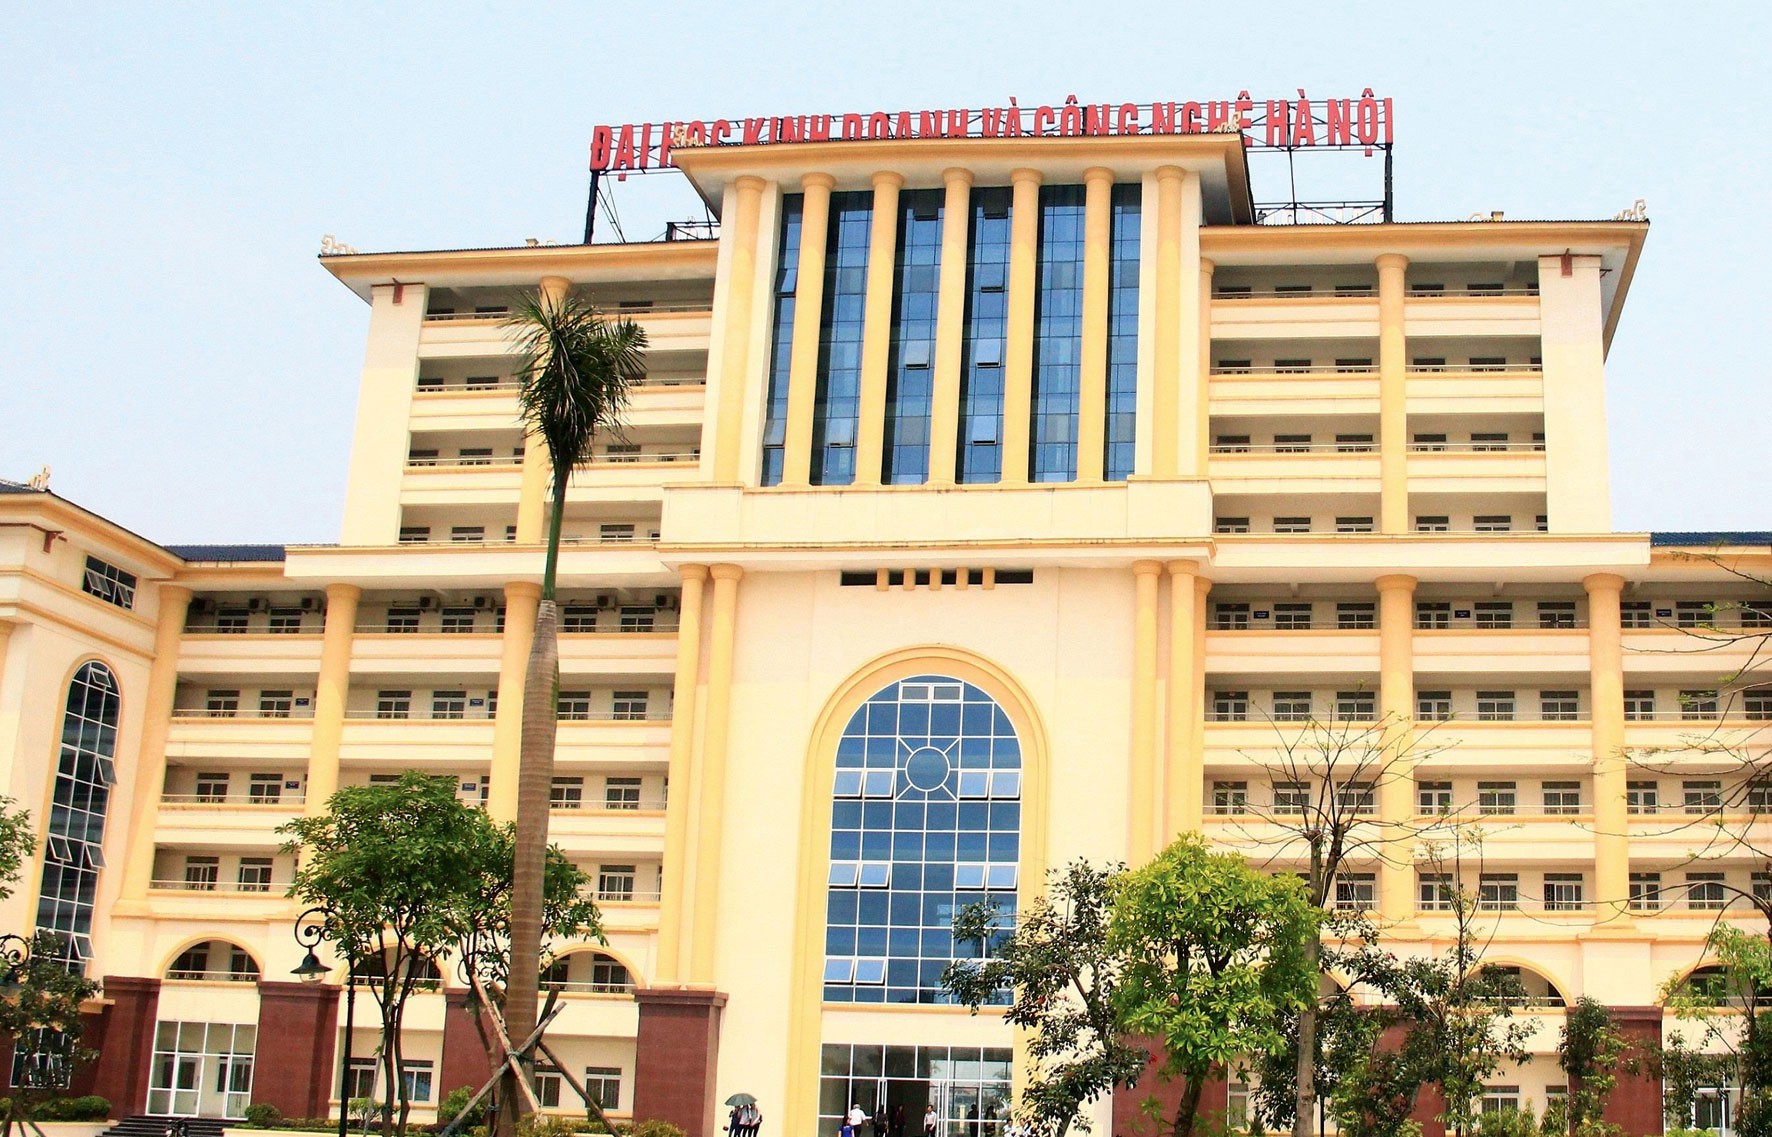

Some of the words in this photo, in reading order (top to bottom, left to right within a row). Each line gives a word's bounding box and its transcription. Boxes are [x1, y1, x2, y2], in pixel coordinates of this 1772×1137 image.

[590, 123, 651, 181] ĐẠI
[743, 115, 830, 144] KINH
[842, 109, 968, 140] DOANH
[982, 96, 1021, 137] VÀ
[1034, 95, 1138, 137] CÔNG
[1266, 89, 1315, 147] HÀ
[1327, 88, 1393, 157] NỘI
